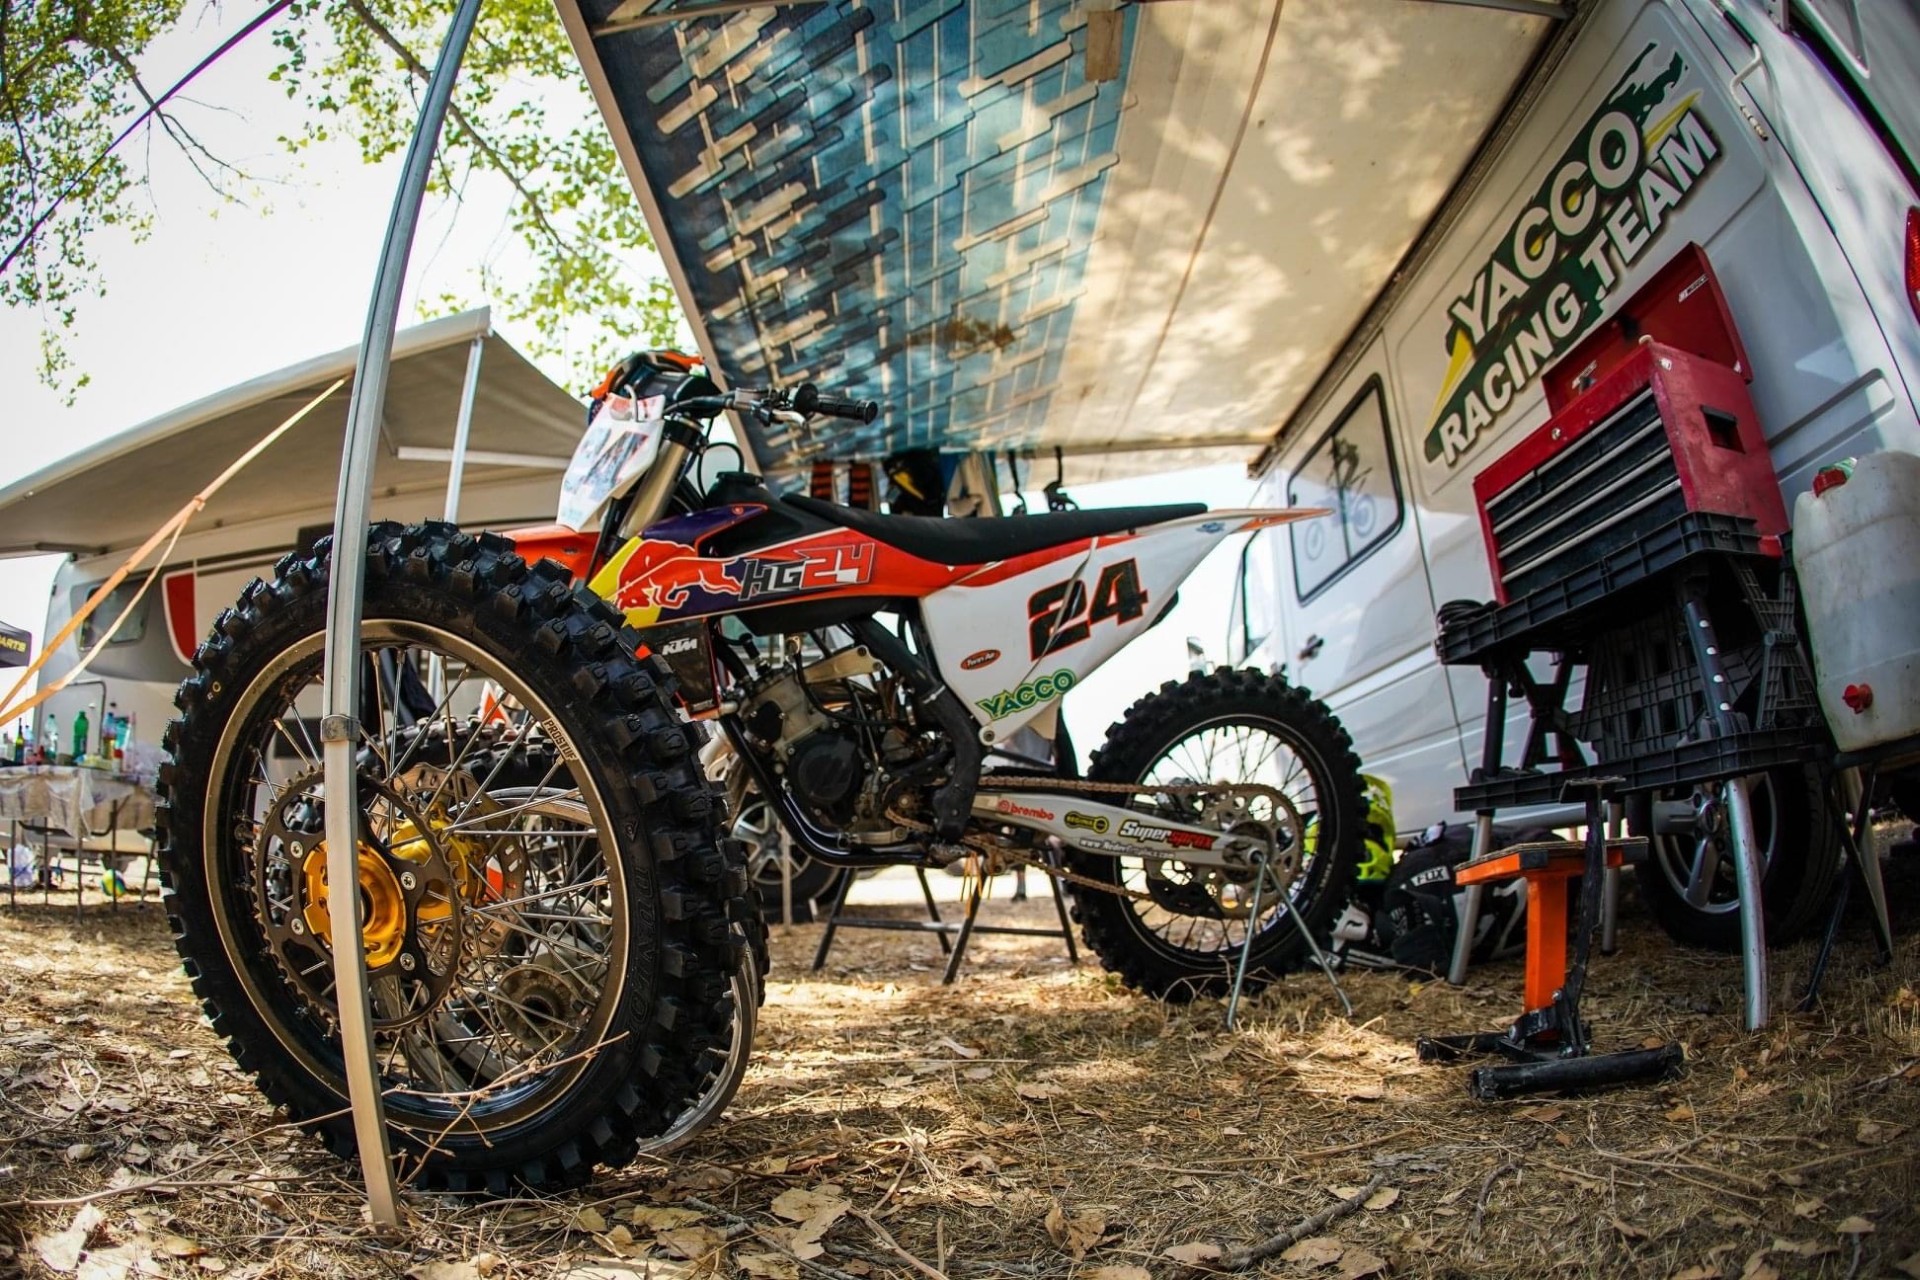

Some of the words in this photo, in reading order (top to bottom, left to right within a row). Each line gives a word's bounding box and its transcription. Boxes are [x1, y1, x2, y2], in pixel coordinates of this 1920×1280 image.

[1452, 110, 1640, 345] YACCO
[1437, 281, 1582, 465] RACING
[1579, 107, 1720, 290] TEAM
[738, 542, 875, 601] HG24
[1027, 557, 1148, 662] 24
[662, 637, 698, 656] KTM
[976, 668, 1076, 720] YACCO
[1009, 802, 1055, 821] brembo
